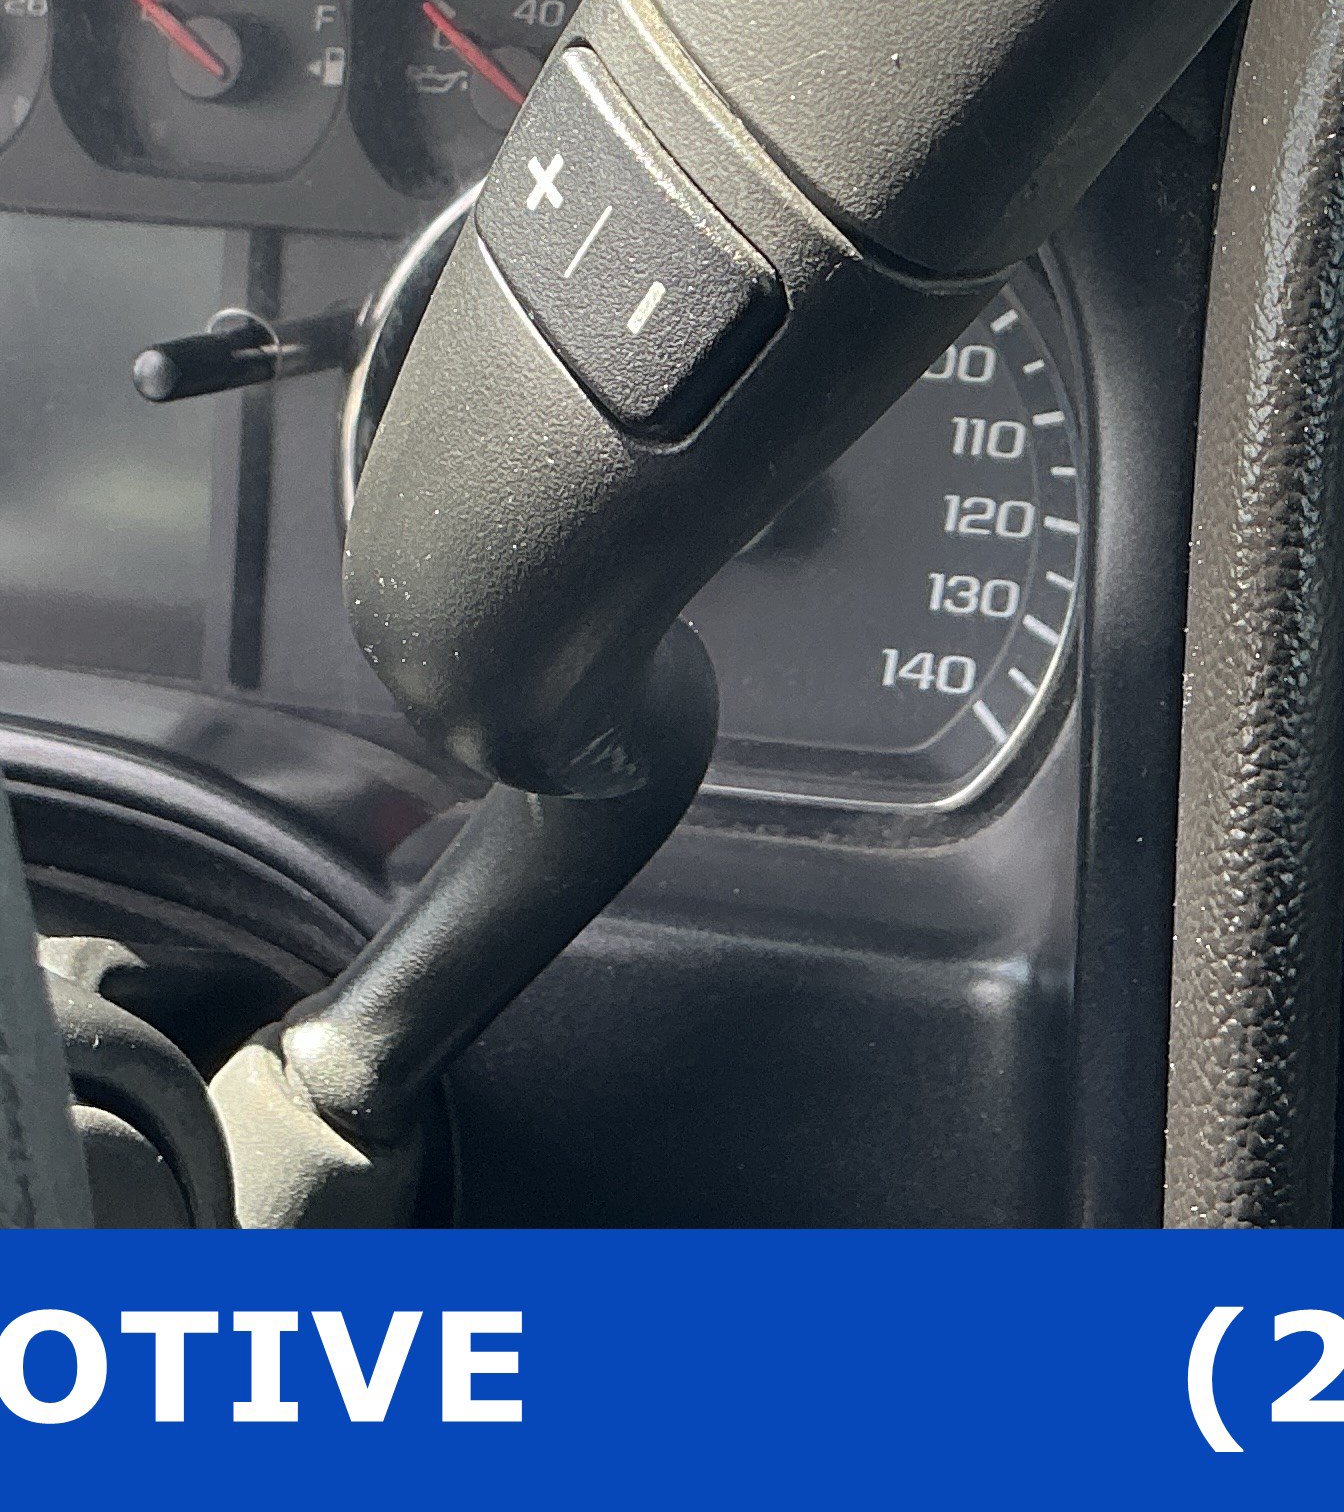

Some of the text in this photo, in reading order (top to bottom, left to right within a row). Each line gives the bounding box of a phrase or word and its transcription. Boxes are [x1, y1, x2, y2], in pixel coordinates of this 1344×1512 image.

[314, 4, 338, 32] F
[921, 344, 997, 383] 00
[952, 416, 1026, 459] 110
[944, 494, 1036, 538] 120
[928, 572, 1020, 619] 130
[882, 648, 977, 695] 140
